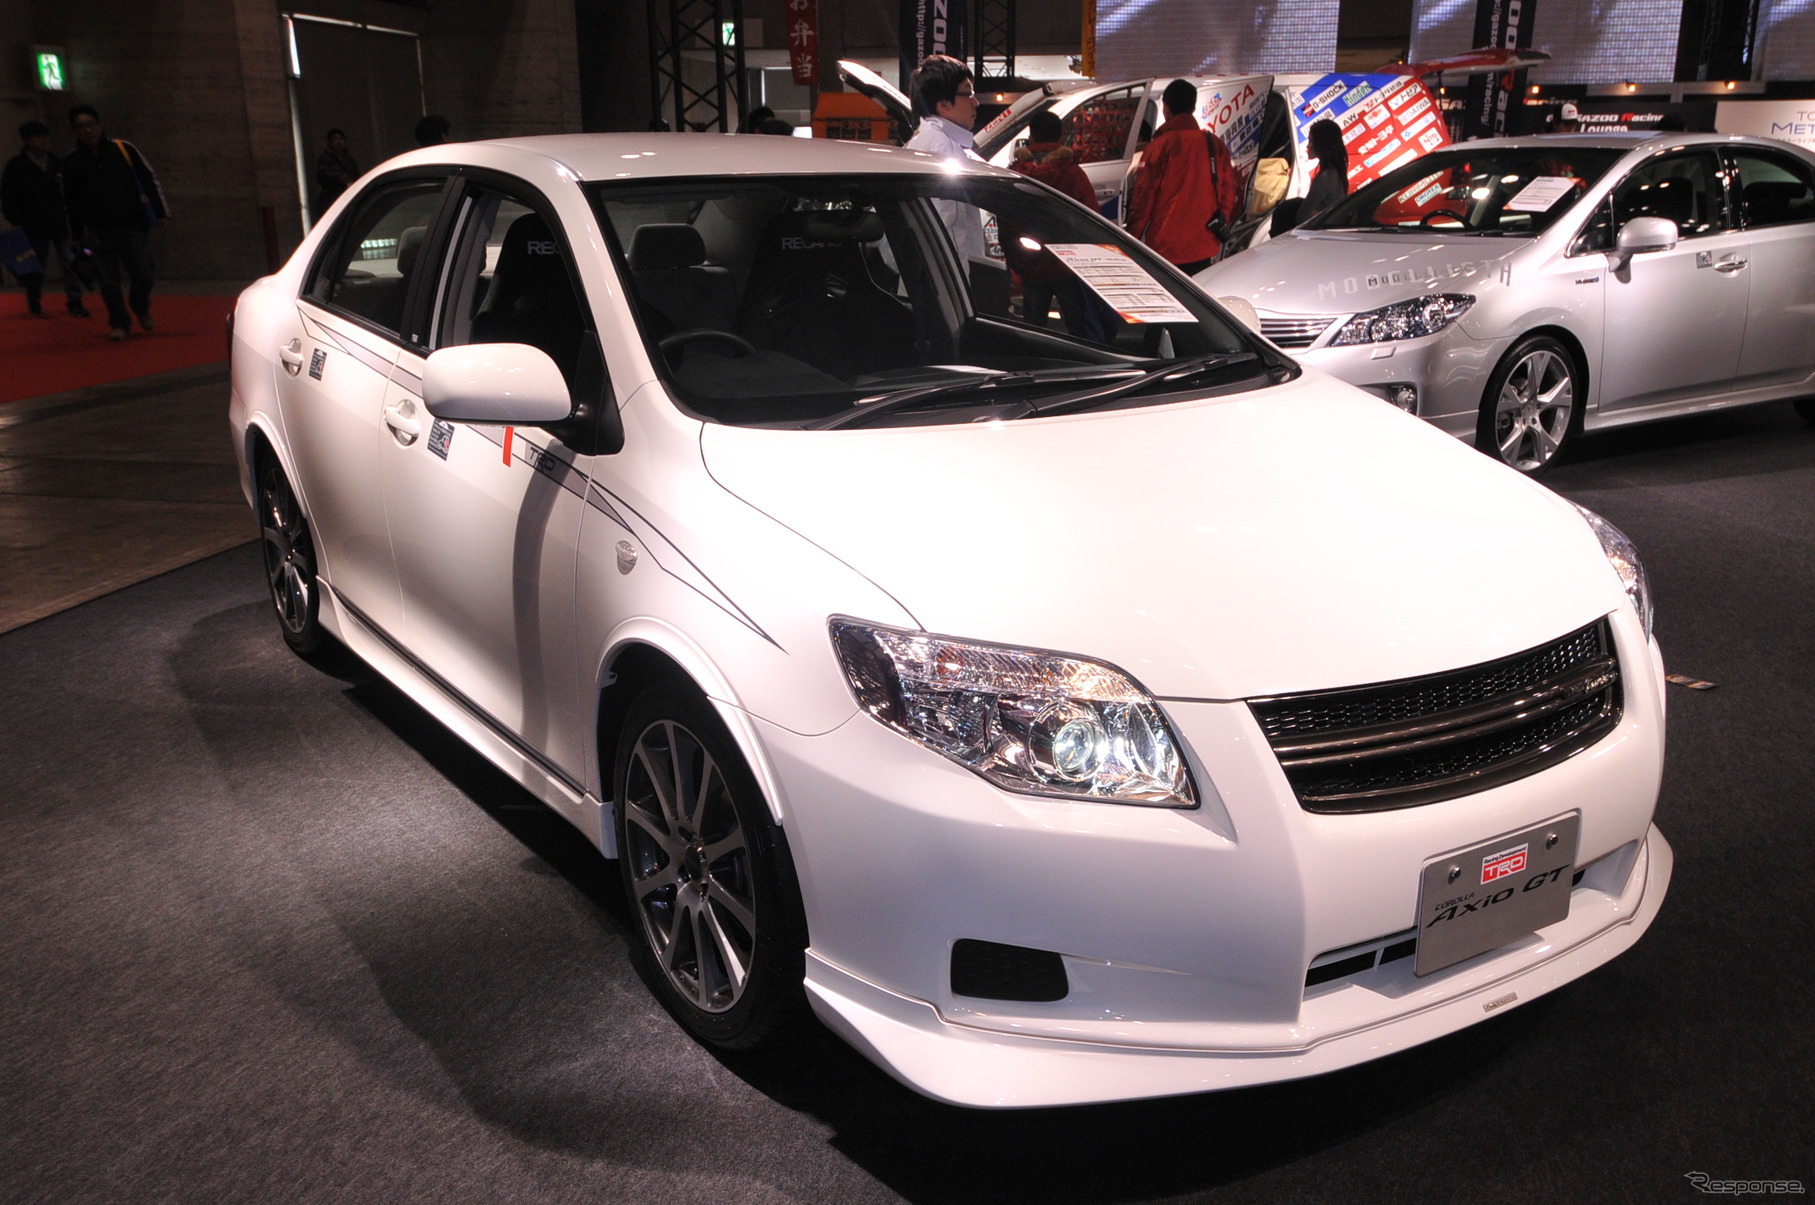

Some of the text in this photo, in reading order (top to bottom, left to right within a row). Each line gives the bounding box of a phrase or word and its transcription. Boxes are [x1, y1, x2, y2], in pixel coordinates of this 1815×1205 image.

[1343, 83, 1372, 106] Kinden
[1207, 83, 1255, 134] YOTA
[1408, 99, 1430, 117] DAIWA
[530, 447, 555, 474] TRD
[1484, 846, 1526, 864] Racing Development
[1484, 856, 1524, 877] TRD
[1522, 864, 1570, 893] GT
[1435, 892, 1475, 911] COROLLA
